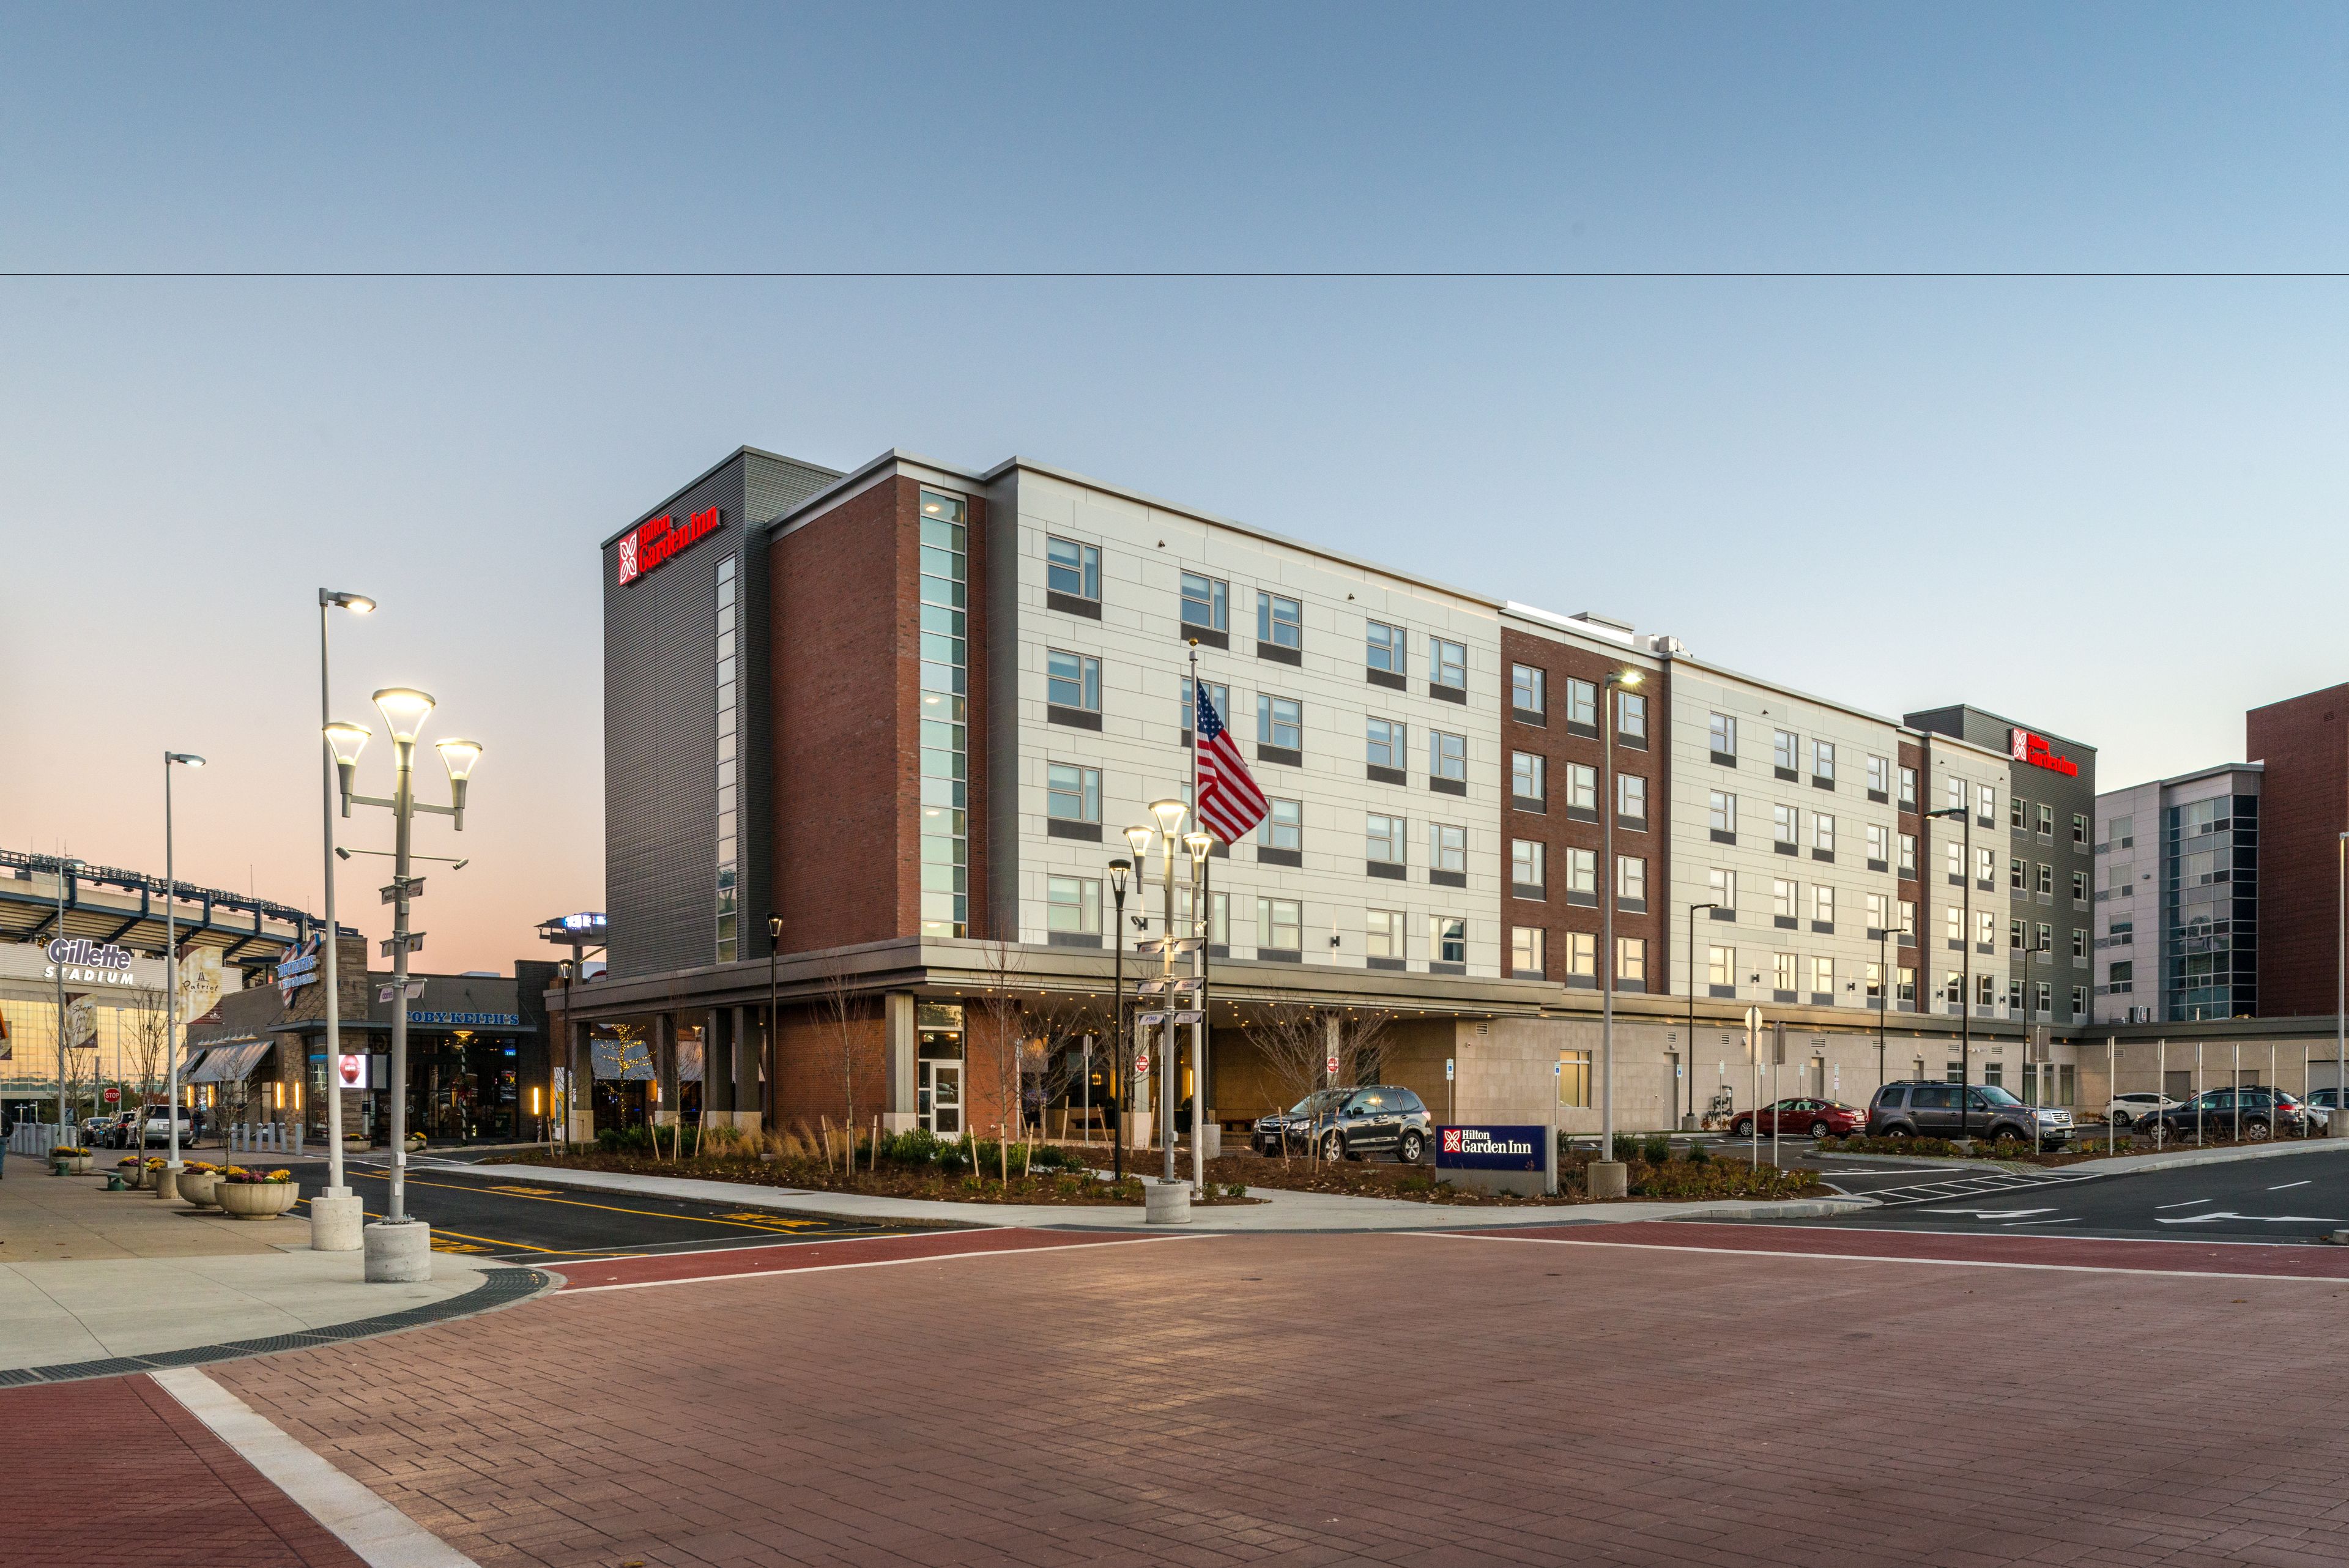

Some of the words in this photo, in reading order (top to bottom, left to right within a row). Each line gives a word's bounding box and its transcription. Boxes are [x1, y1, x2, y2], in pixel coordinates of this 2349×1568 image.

[638, 514, 670, 546] Hilton
[639, 525, 689, 573] Garden
[691, 506, 717, 541] Inn
[2028, 734, 2049, 751] Hilton
[2028, 746, 2060, 771] Garden
[2061, 756, 2078, 777] Inn
[48, 938, 131, 970] Gillette
[182, 980, 218, 992] Patriot
[72, 1004, 92, 1015] Shop
[450, 1012, 519, 1025] KEITH'S
[1462, 1130, 1490, 1140] Hilton
[1461, 1139, 1507, 1153] Garden
[1508, 1140, 1532, 1154] Inn
